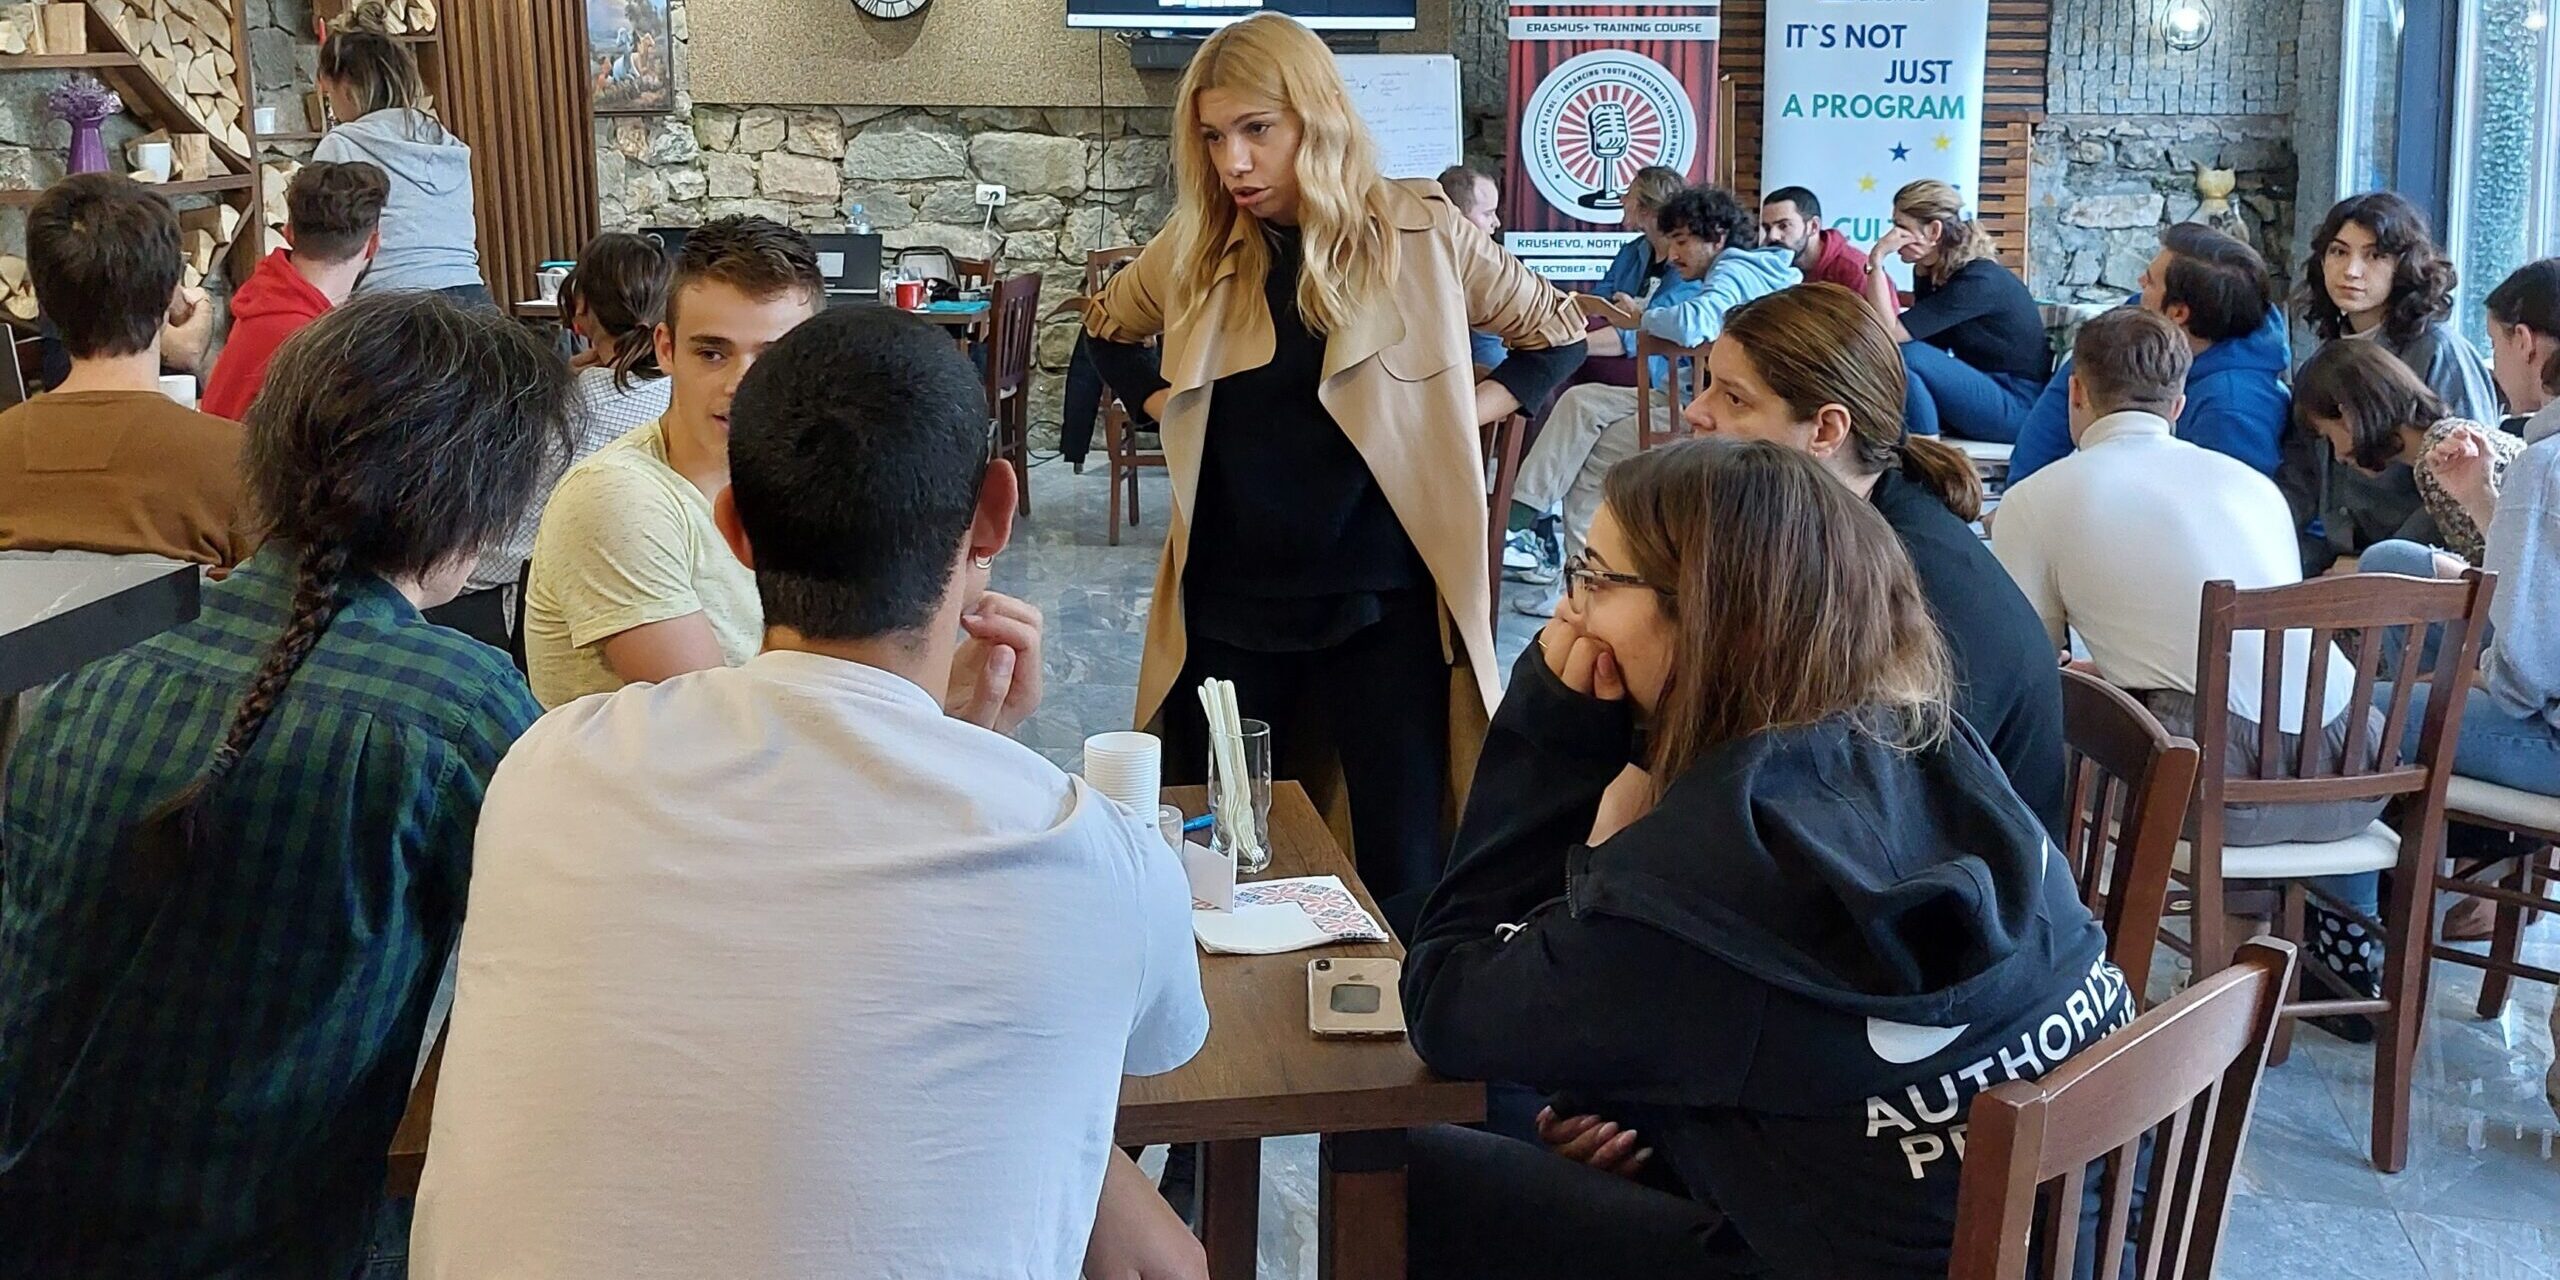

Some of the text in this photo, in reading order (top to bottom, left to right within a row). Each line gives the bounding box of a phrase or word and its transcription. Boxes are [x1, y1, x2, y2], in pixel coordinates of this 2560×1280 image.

[1526, 23, 1702, 33] ERASMUS+ TRAINING COURSE
[1845, 24, 1907, 49] NOT
[1560, 68, 1600, 93] ENHANCING
[1602, 67, 1627, 76] YOUTH
[1884, 60, 1953, 84] JUST
[1628, 70, 1669, 105] ENGAGEMENT
[1545, 100, 1557, 118] TOOL
[1782, 94, 1965, 119] A PROGRAM
[1665, 104, 1679, 140] THROUGH
[1540, 140, 1553, 169] COMEDY
[1517, 239, 1584, 249] KRUSHEVO,
[1542, 265, 1585, 273] OCTOBER
